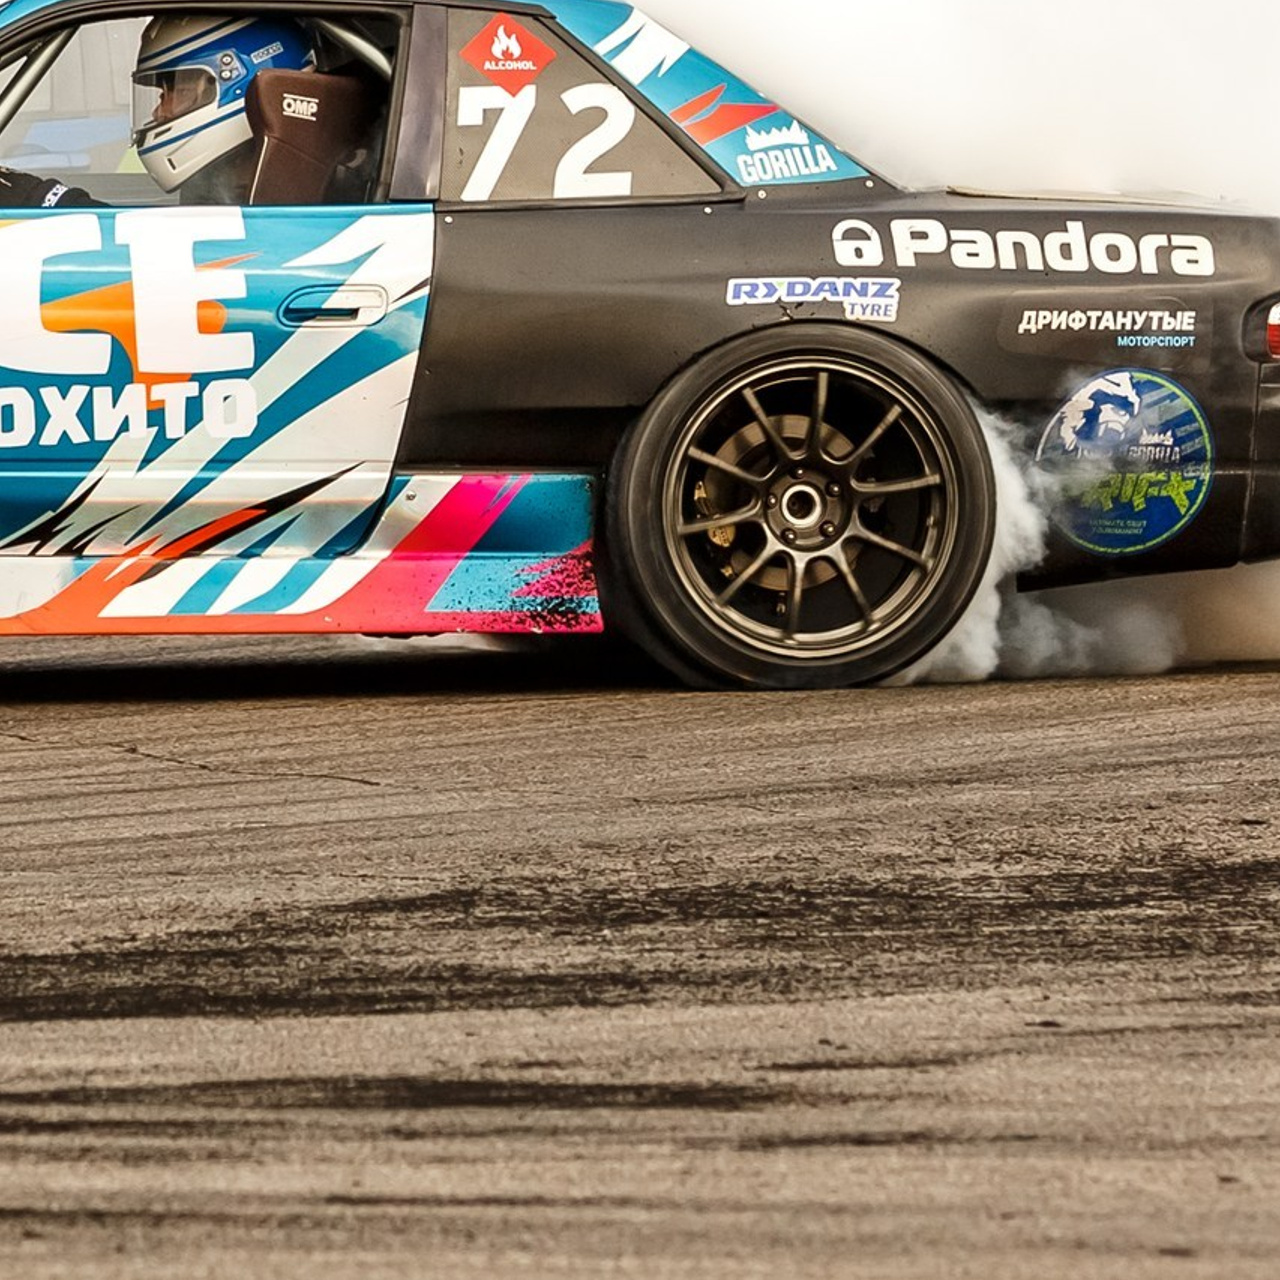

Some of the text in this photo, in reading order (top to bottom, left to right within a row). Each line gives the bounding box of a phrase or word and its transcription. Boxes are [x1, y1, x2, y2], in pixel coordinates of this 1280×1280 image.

[483, 60, 537, 71] ALCOHOL
[283, 98, 318, 117] OMP
[736, 144, 838, 183] GORILLA
[889, 219, 1216, 276] Pandora
[849, 303, 894, 317] TYRE
[1018, 310, 1196, 334] ДРИФТАНУТЫЕ
[1117, 336, 1196, 348] МОТОРСПОРТ
